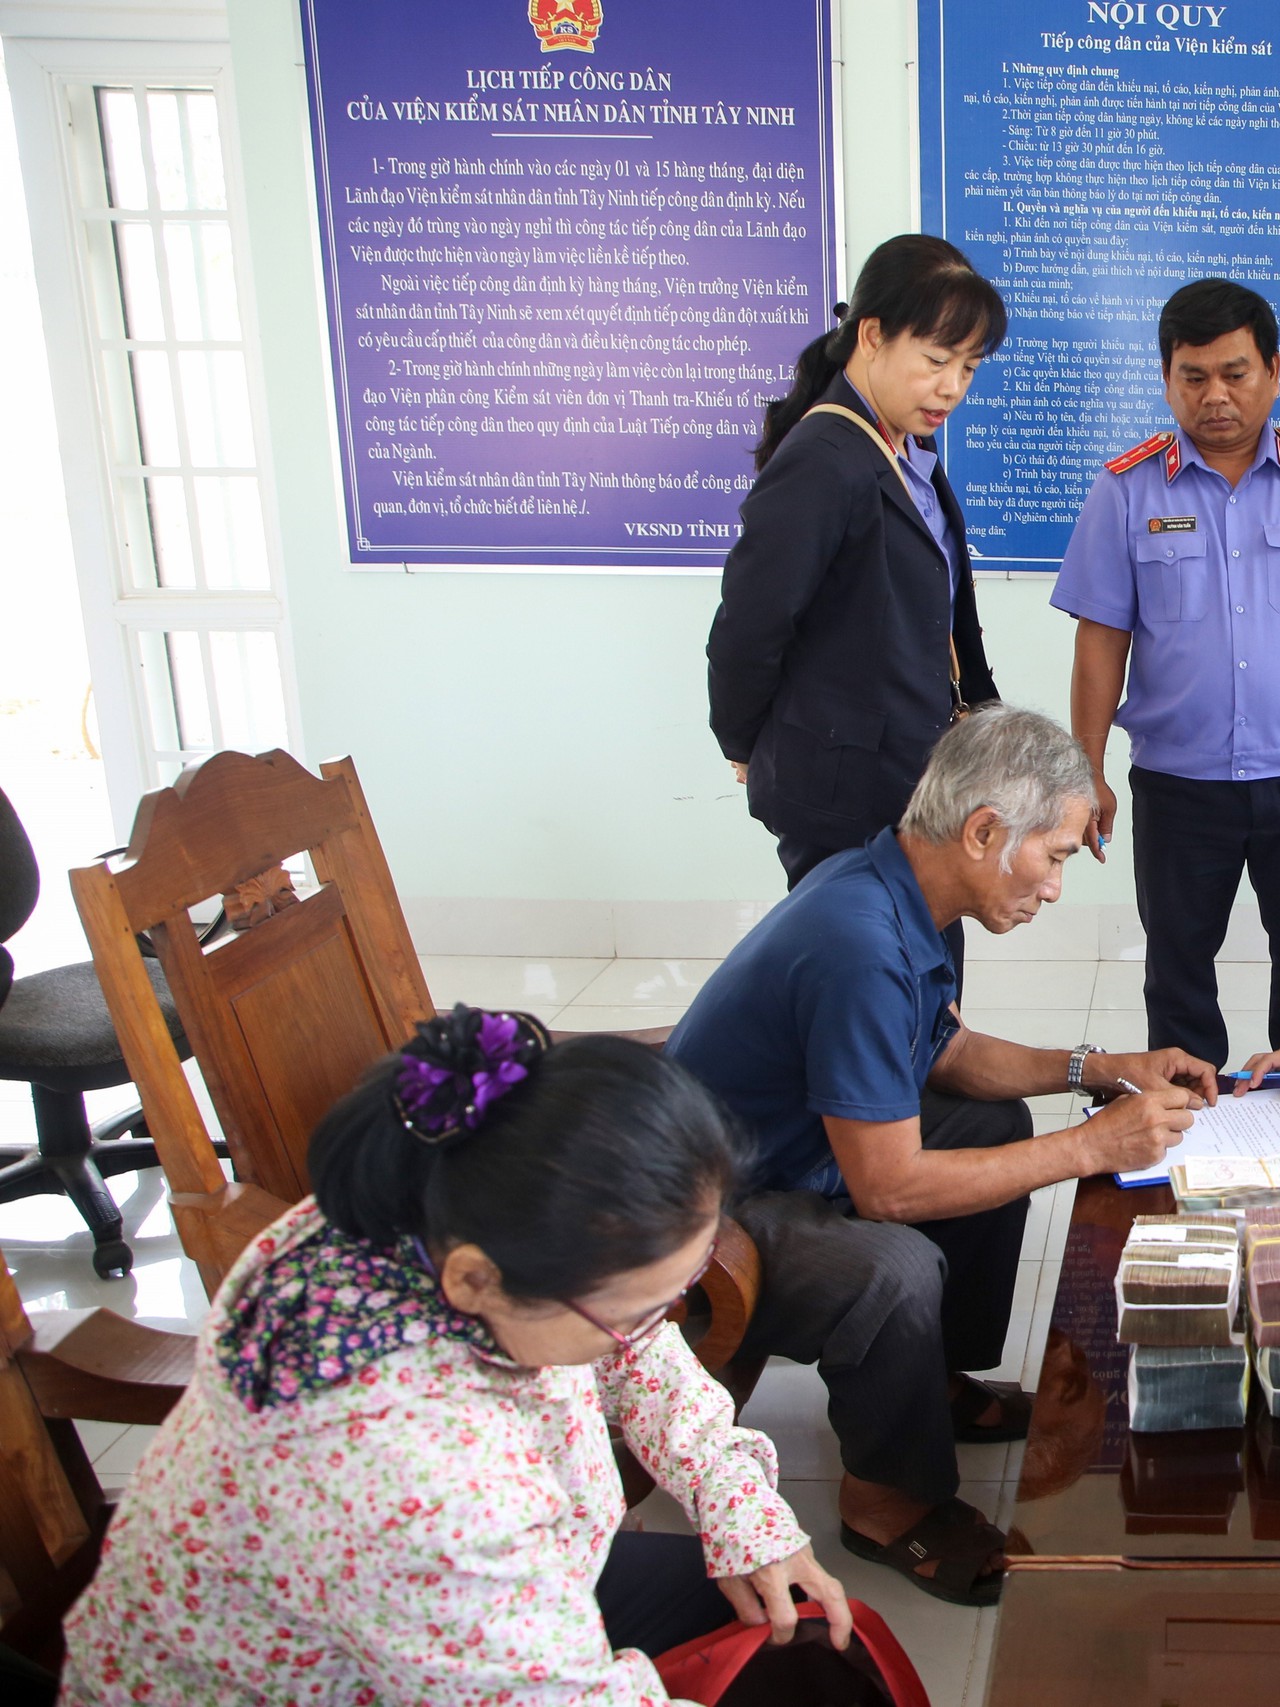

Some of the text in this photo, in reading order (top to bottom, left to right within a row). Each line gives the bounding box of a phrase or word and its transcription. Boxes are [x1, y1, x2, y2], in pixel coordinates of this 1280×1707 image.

[1087, 0, 1227, 31] NỘI QUY
[1040, 31, 1272, 56] Tiếp công dân của Viện kiểm sát
[466, 62, 671, 92] LỊCH TIẾP CÔNG DÂN
[1002, 62, 1120, 81] I. Những quy định chung
[346, 94, 795, 126] CỦA VIỆN KIỂM SÁT NHÂN DÂN TỈNH TÂY NINH
[1008, 124, 1033, 140] Sáng:
[1035, 125, 1049, 136] Từ
[1050, 126, 1057, 137] 8
[1058, 127, 1074, 140] giờ
[1076, 126, 1092, 138] đến
[1095, 127, 1104, 138] 11
[1107, 128, 1122, 141] giờ
[1124, 128, 1136, 139] 30
[1137, 128, 1160, 142] phút.
[1008, 139, 1038, 151] Chiều:
[1039, 140, 1050, 151] từ
[1052, 141, 1063, 152] 13
[1064, 141, 1080, 155] giờ
[1081, 142, 1093, 153] 30
[1095, 142, 1115, 156] phút
[1116, 143, 1133, 154] đến
[1136, 144, 1146, 154] 16
[1148, 144, 1165, 158] giờ.
[373, 157, 805, 183] 1- Trong giờ hành chính vào các ngày 01 và 15 hàng tháng, đại diện
[1003, 201, 1014, 212] II.
[1016, 201, 1047, 217] Quyền
[1049, 202, 1061, 213] và
[1063, 203, 1089, 218] nghĩa
[1091, 206, 1103, 217] vụ
[1105, 204, 1122, 215] của
[1124, 205, 1151, 218] người
[1153, 205, 1170, 217] đến
[1172, 206, 1198, 218] khiếu
[1200, 208, 1218, 221] nại,
[1220, 207, 1230, 218] tố
[1231, 208, 1250, 221] cáo,
[1252, 208, 1272, 220] kiến
[363, 387, 387, 407] đạo
[389, 387, 422, 407] Viện
[424, 387, 456, 409] phân
[459, 388, 490, 409] công
[493, 386, 529, 405] Kiểm
[532, 389, 551, 405] sát
[554, 388, 583, 405] viên
[586, 389, 610, 405] đơn
[613, 389, 626, 409] vị
[629, 390, 669, 406] Thanh
[673, 388, 733, 407] tra-Khiếu
[736, 388, 749, 408] tố
[368, 444, 437, 463] của Ngành.
[392, 470, 424, 490] Viện
[424, 468, 457, 487] kiểm
[459, 471, 477, 487] sát
[479, 471, 510, 487] nhân
[536, 470, 560, 487] tỉnh
[561, 472, 587, 492] Tây
[589, 472, 620, 488] Ninh
[621, 472, 657, 493] thông
[657, 473, 682, 489] báo
[683, 470, 699, 489] để
[701, 474, 732, 494] công
[373, 502, 407, 518] quan,
[408, 498, 431, 514] đơn
[432, 500, 448, 517] vị,
[449, 496, 462, 514] tổ
[463, 498, 493, 514] chức
[493, 496, 519, 514] biết
[519, 499, 535, 514] để
[537, 498, 561, 514] liên
[624, 523, 683, 536] VKSND
[686, 519, 731, 537] TỈNH
[965, 525, 1006, 538] công dân;
